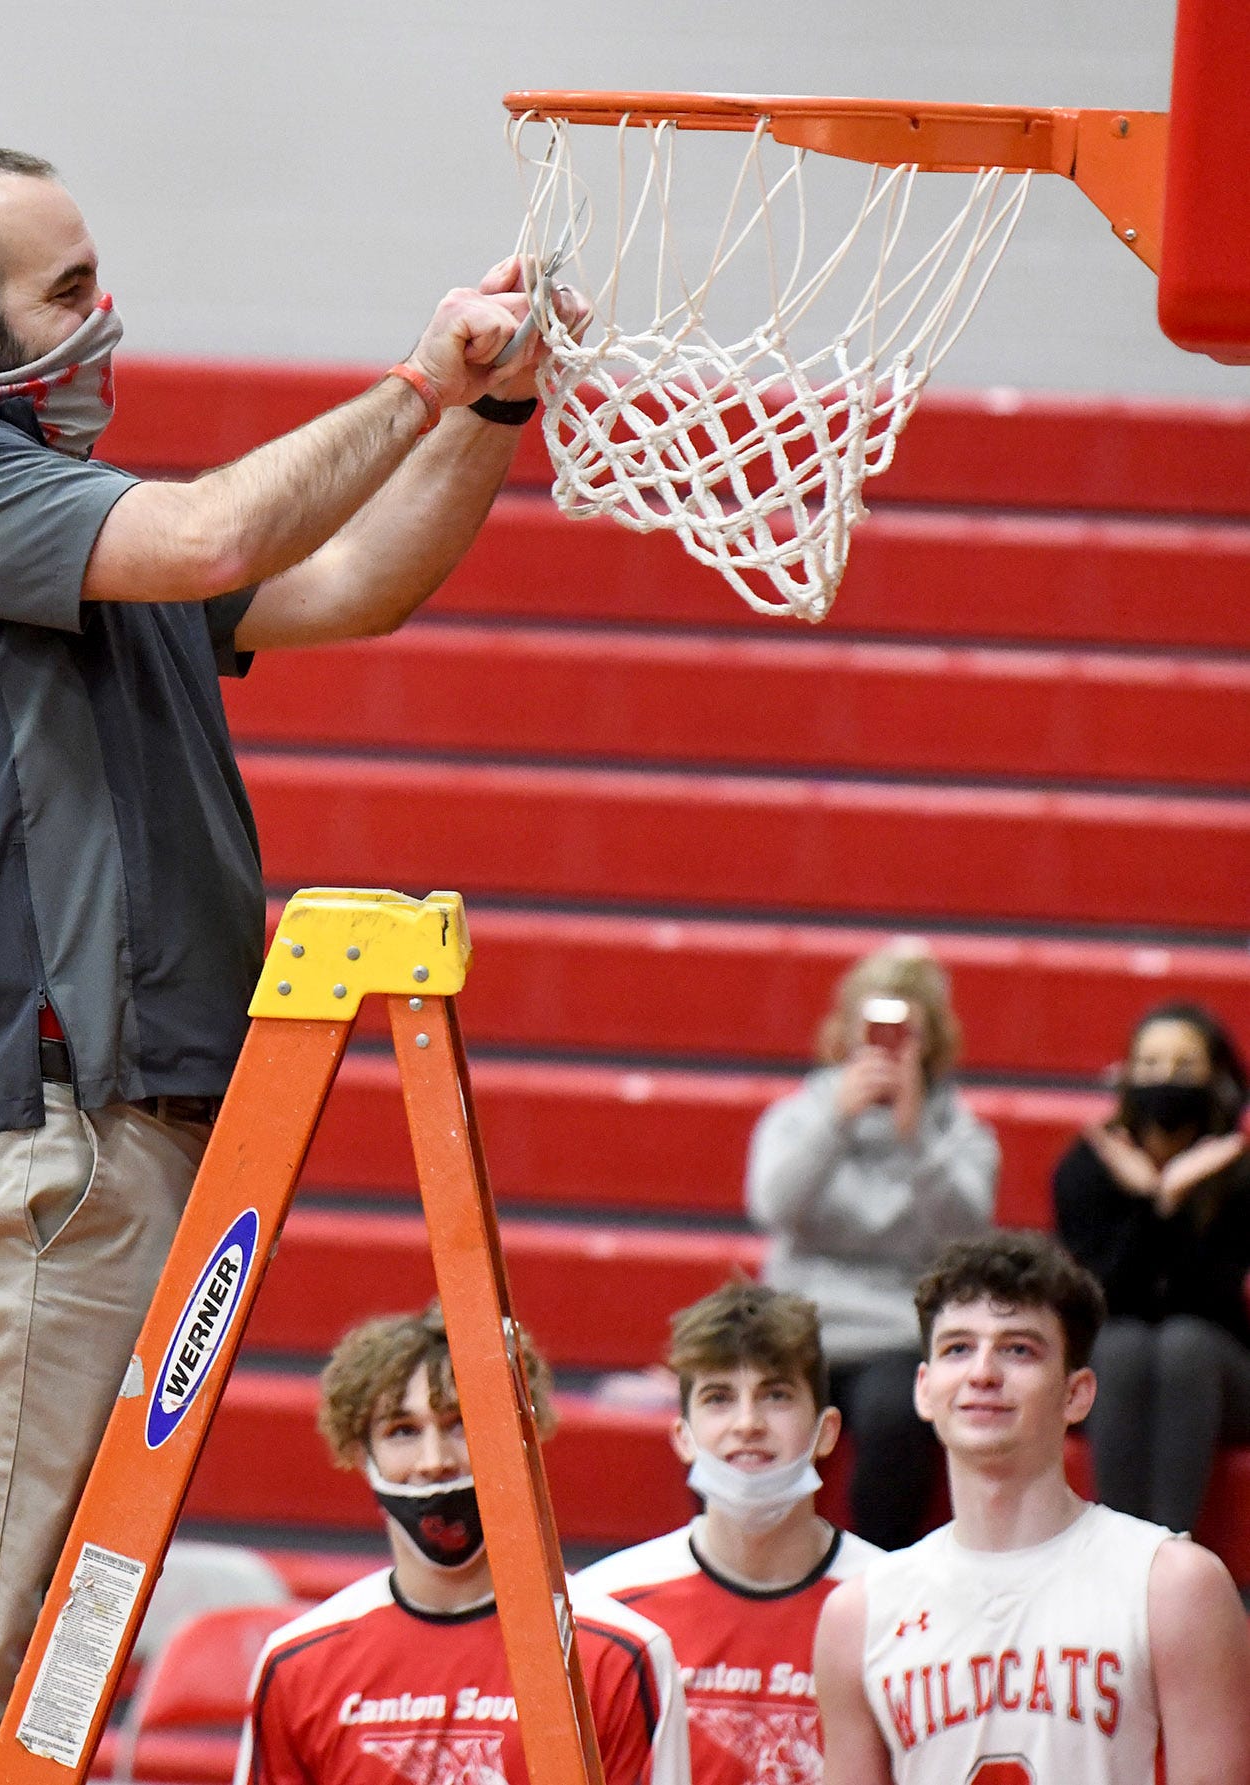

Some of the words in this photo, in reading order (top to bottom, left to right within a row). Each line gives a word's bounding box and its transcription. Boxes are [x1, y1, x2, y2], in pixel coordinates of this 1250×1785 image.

[165, 1255, 239, 1397] WERNER
[338, 1692, 447, 1725] Canton
[881, 1645, 1124, 1751] WILDCATS
